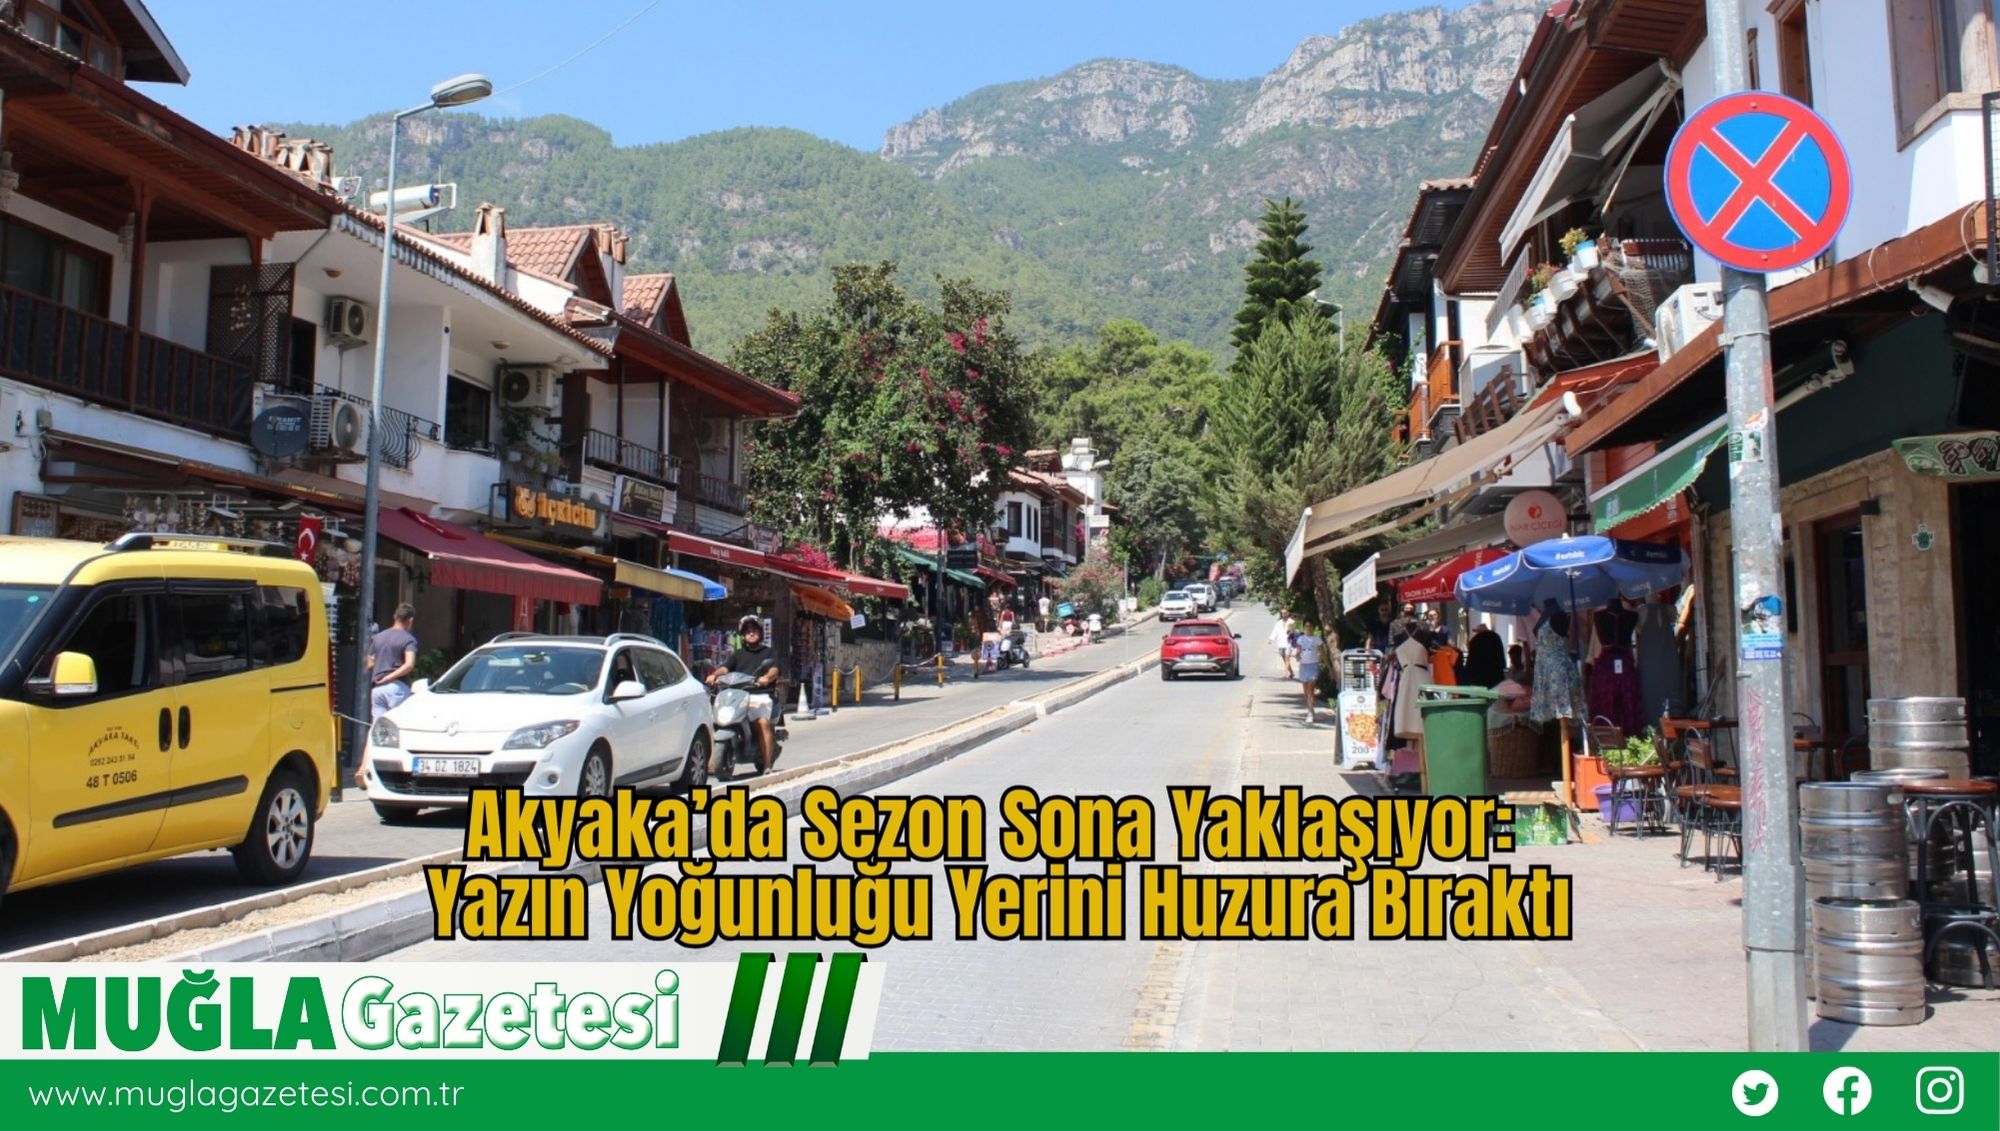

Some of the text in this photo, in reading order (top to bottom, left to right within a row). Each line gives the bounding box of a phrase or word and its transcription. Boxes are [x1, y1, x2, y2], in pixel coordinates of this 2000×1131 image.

[420, 760, 431, 772] 34
[453, 760, 477, 772] 1824
[86, 769, 137, 789] 48 T 0506
